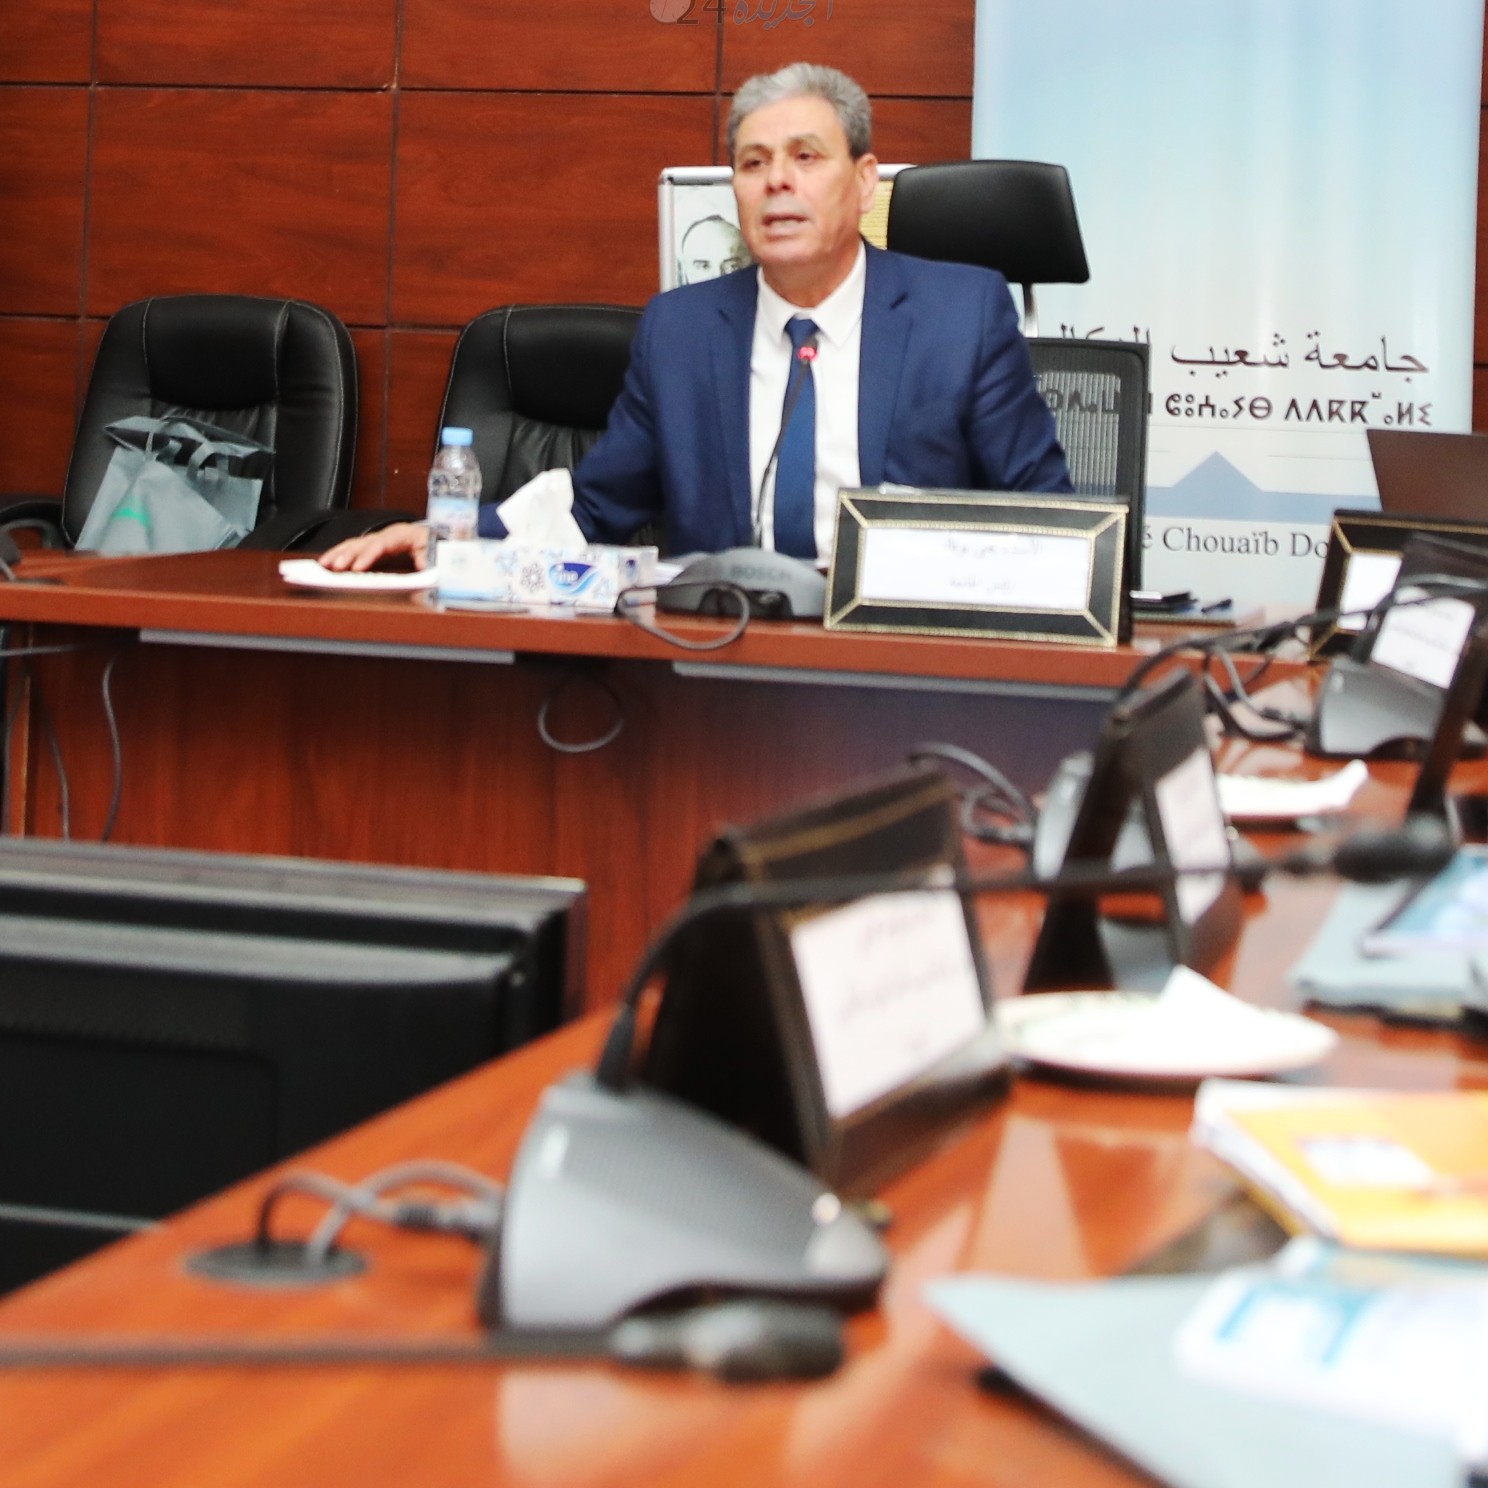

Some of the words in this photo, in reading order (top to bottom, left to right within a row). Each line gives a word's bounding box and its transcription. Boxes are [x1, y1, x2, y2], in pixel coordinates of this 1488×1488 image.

[1170, 332, 1289, 379] شعيب
[1303, 330, 1429, 383] جامعة
[1163, 526, 1279, 557] Chouaïb
